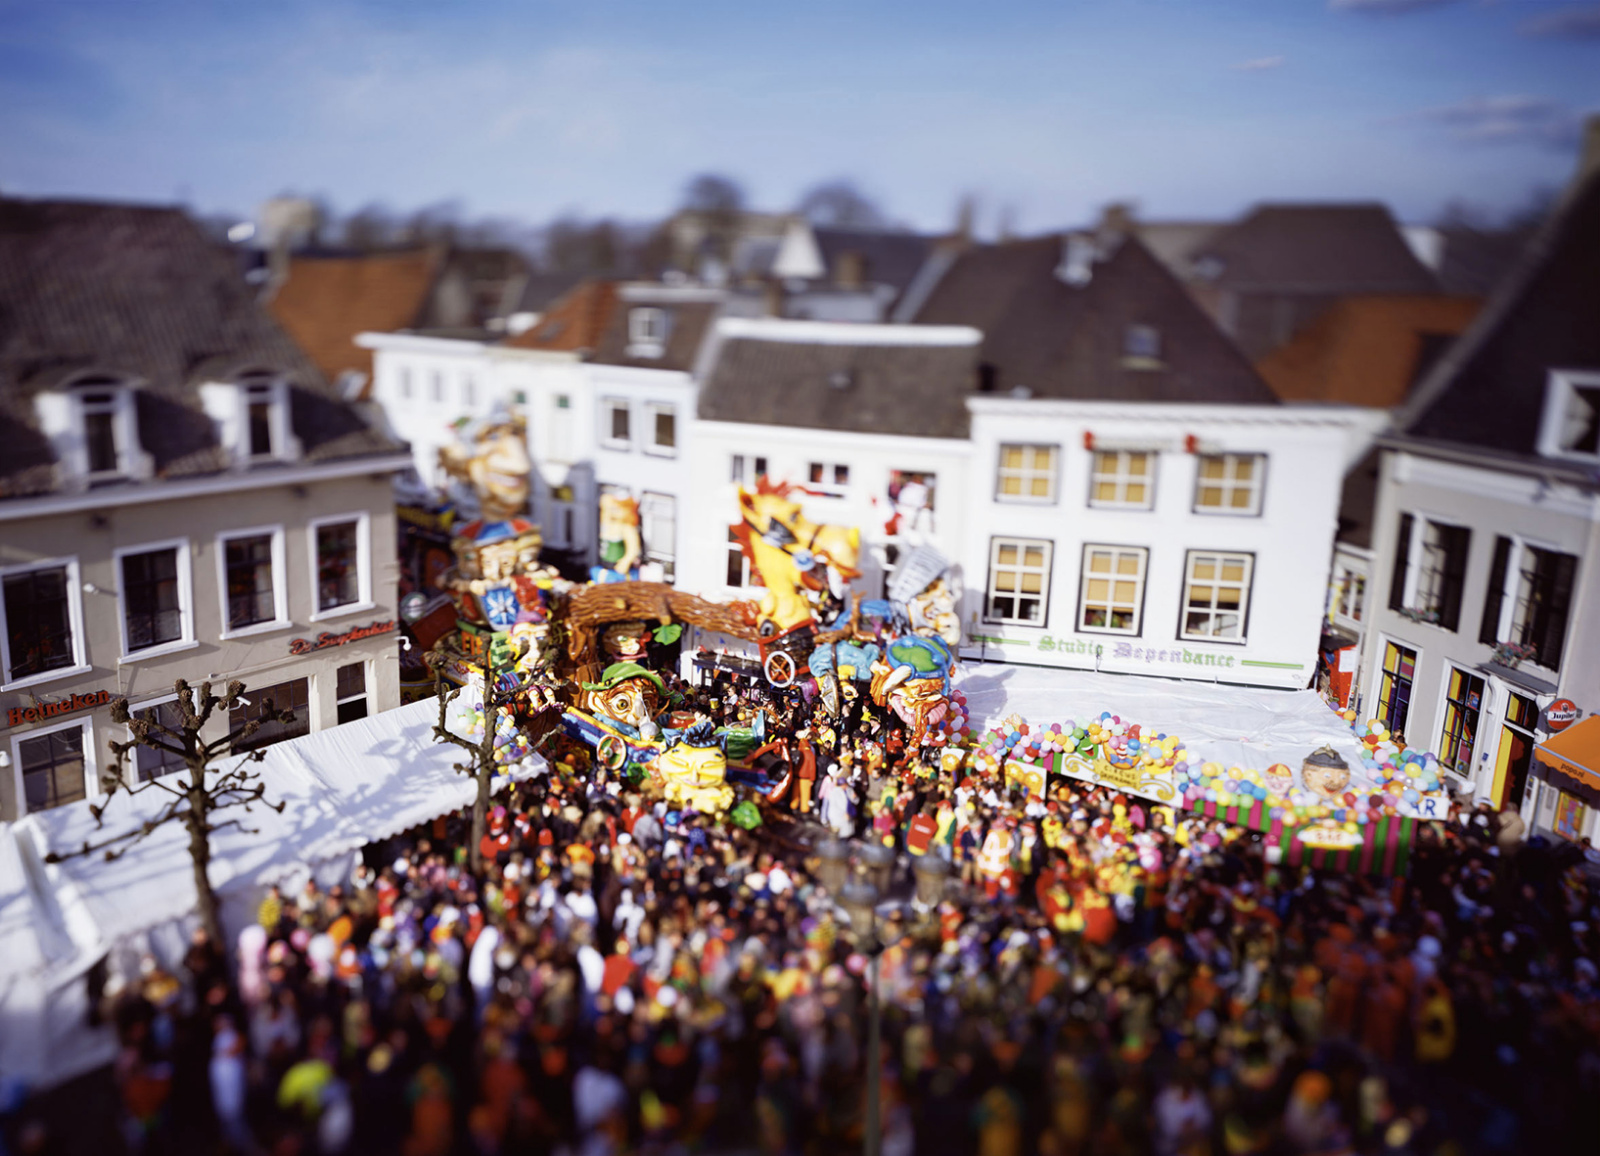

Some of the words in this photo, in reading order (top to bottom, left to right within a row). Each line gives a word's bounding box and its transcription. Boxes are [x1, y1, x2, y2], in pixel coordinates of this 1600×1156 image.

[7, 689, 110, 727] Heineken
[1551, 711, 1576, 720] Jupiler
[1560, 763, 1585, 778] popo.nl
